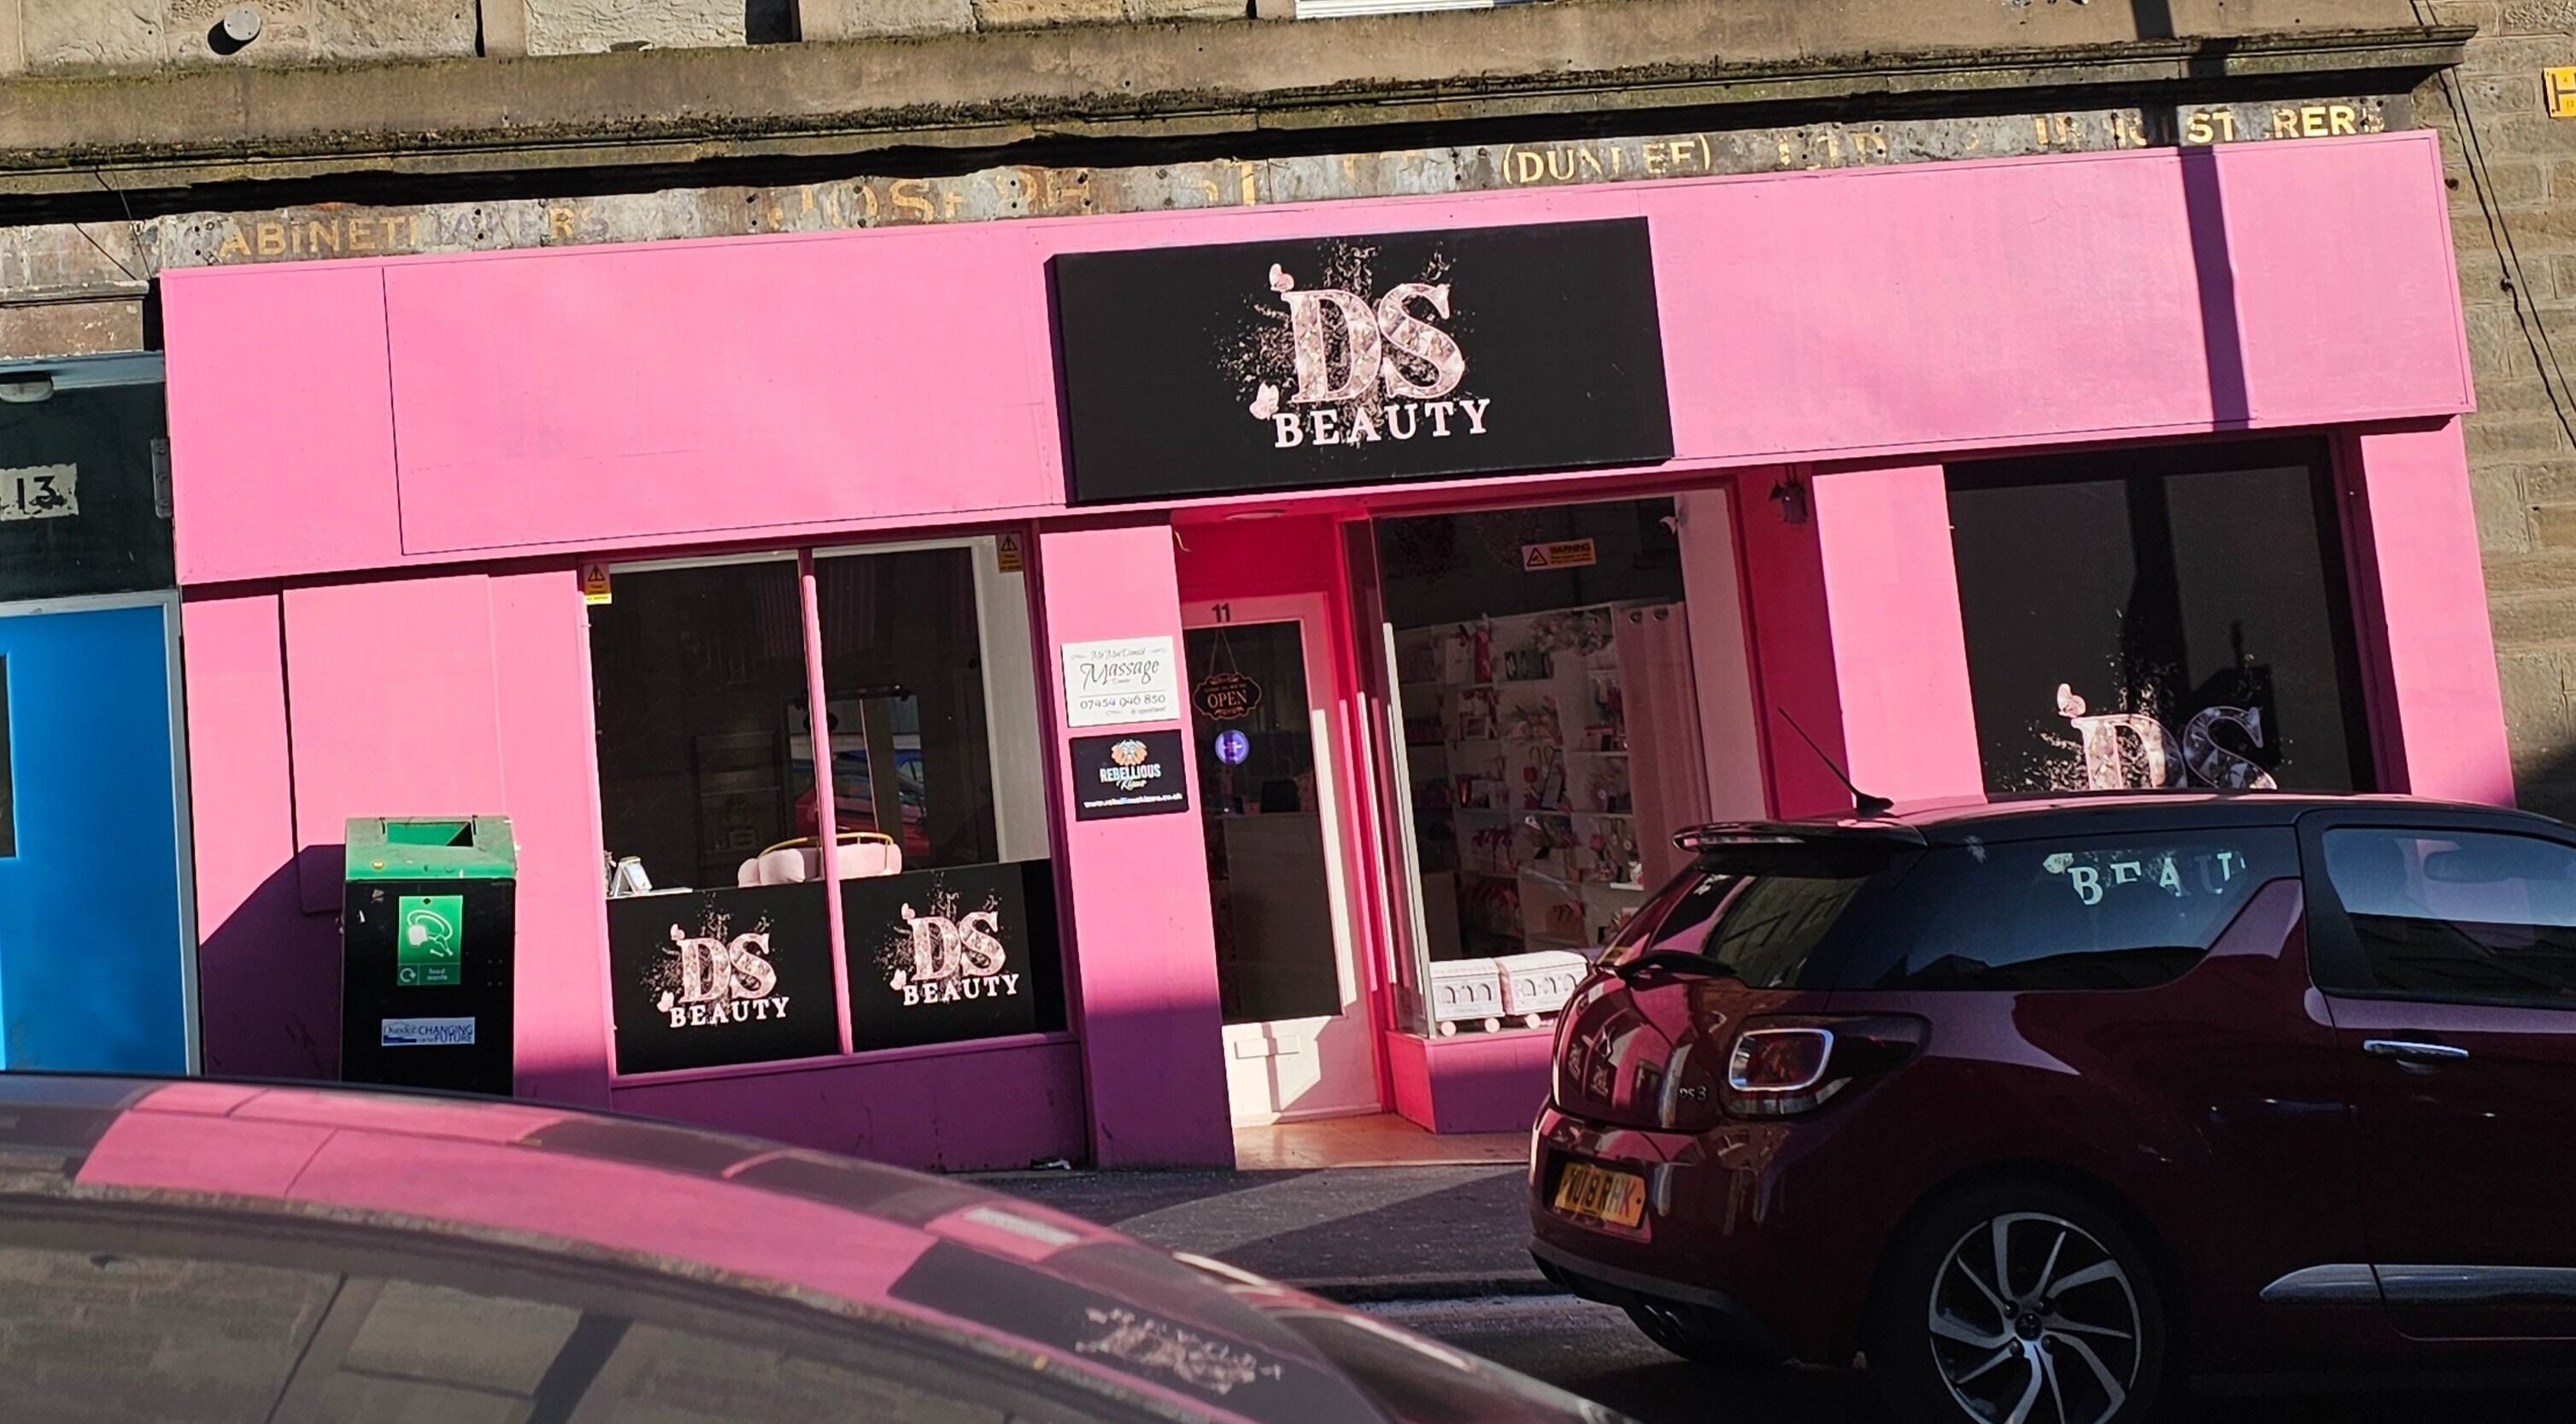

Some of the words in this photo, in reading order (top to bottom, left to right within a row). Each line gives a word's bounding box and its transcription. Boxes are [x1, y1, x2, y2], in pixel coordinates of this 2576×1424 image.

[1281, 283, 1464, 402] DS
[1274, 398, 1491, 448] BEAUTY
[17, 474, 61, 510] 13
[1211, 603, 1231, 623] 11
[1079, 659, 1159, 690] Massage
[1207, 689, 1247, 709] OPEN
[2071, 706, 2279, 790] DS
[1099, 763, 1162, 783] REBELLIOUS
[2068, 853, 2247, 905] BEAUT
[908, 911, 1006, 982] DS
[676, 932, 777, 1004] DS
[902, 973, 1020, 1006] BEAUTY
[670, 996, 789, 1028] BEAUTY
[418, 1025, 472, 1035] CHANGING
[434, 1032, 472, 1043] FUTURE
